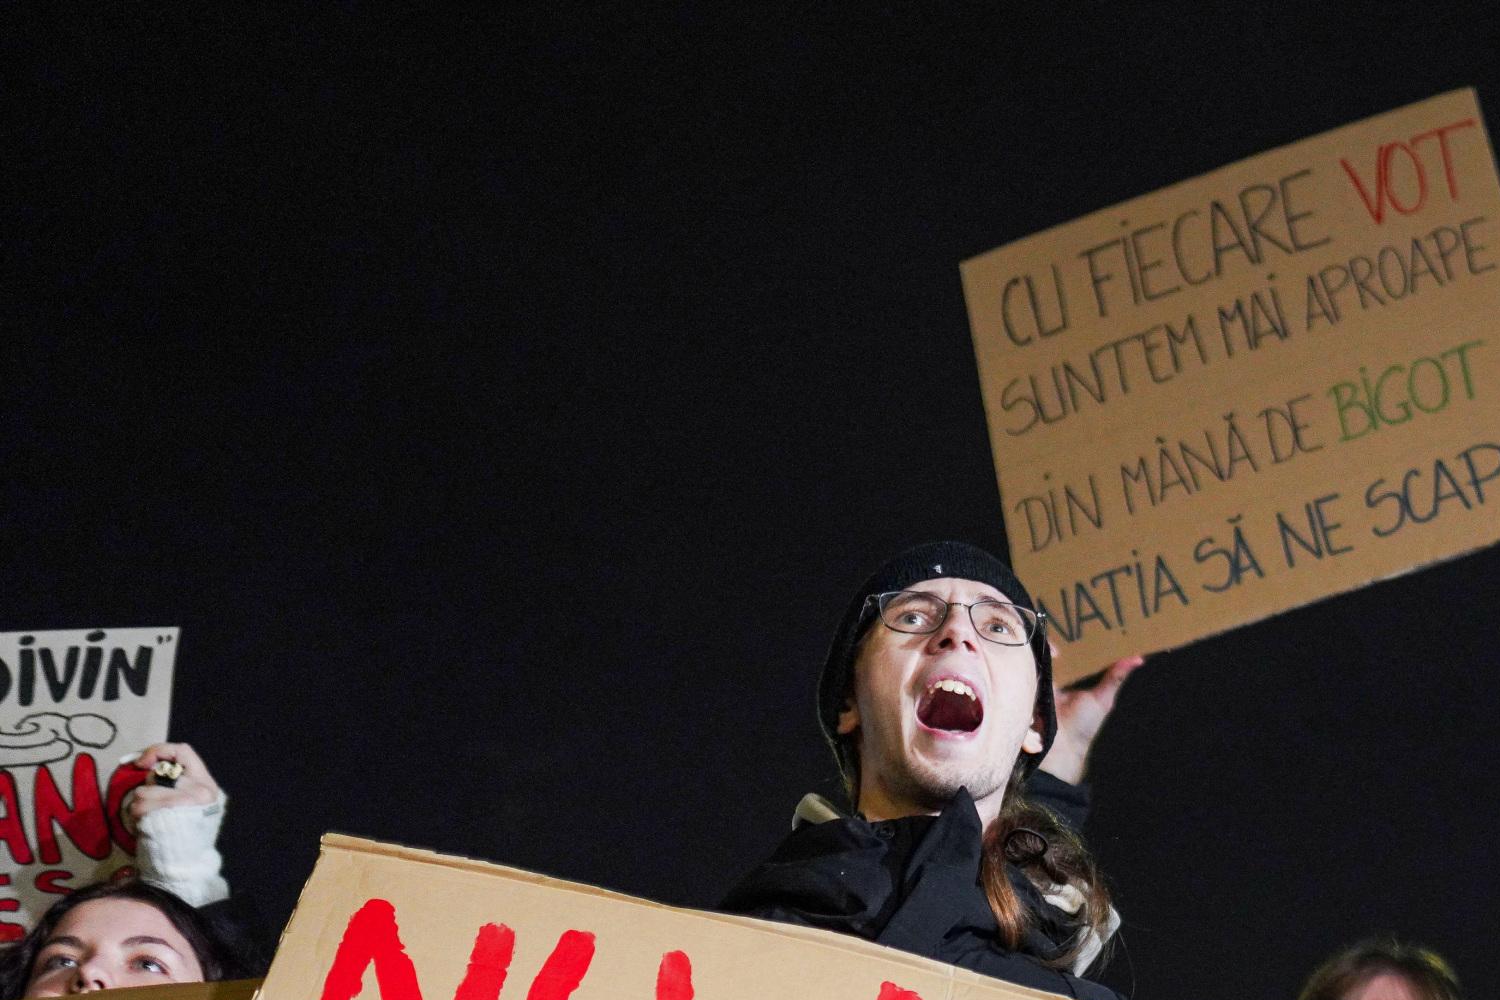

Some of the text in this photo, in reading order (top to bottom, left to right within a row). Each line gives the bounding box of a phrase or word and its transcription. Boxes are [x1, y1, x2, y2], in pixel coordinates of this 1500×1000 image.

[1001, 261, 1070, 347] CU
[1340, 117, 1475, 225] VOT
[1000, 315, 1204, 437] SUNTEM
[1305, 216, 1496, 333] APROAPE
[1259, 393, 1324, 466] DE
[1276, 495, 1354, 570] NE
